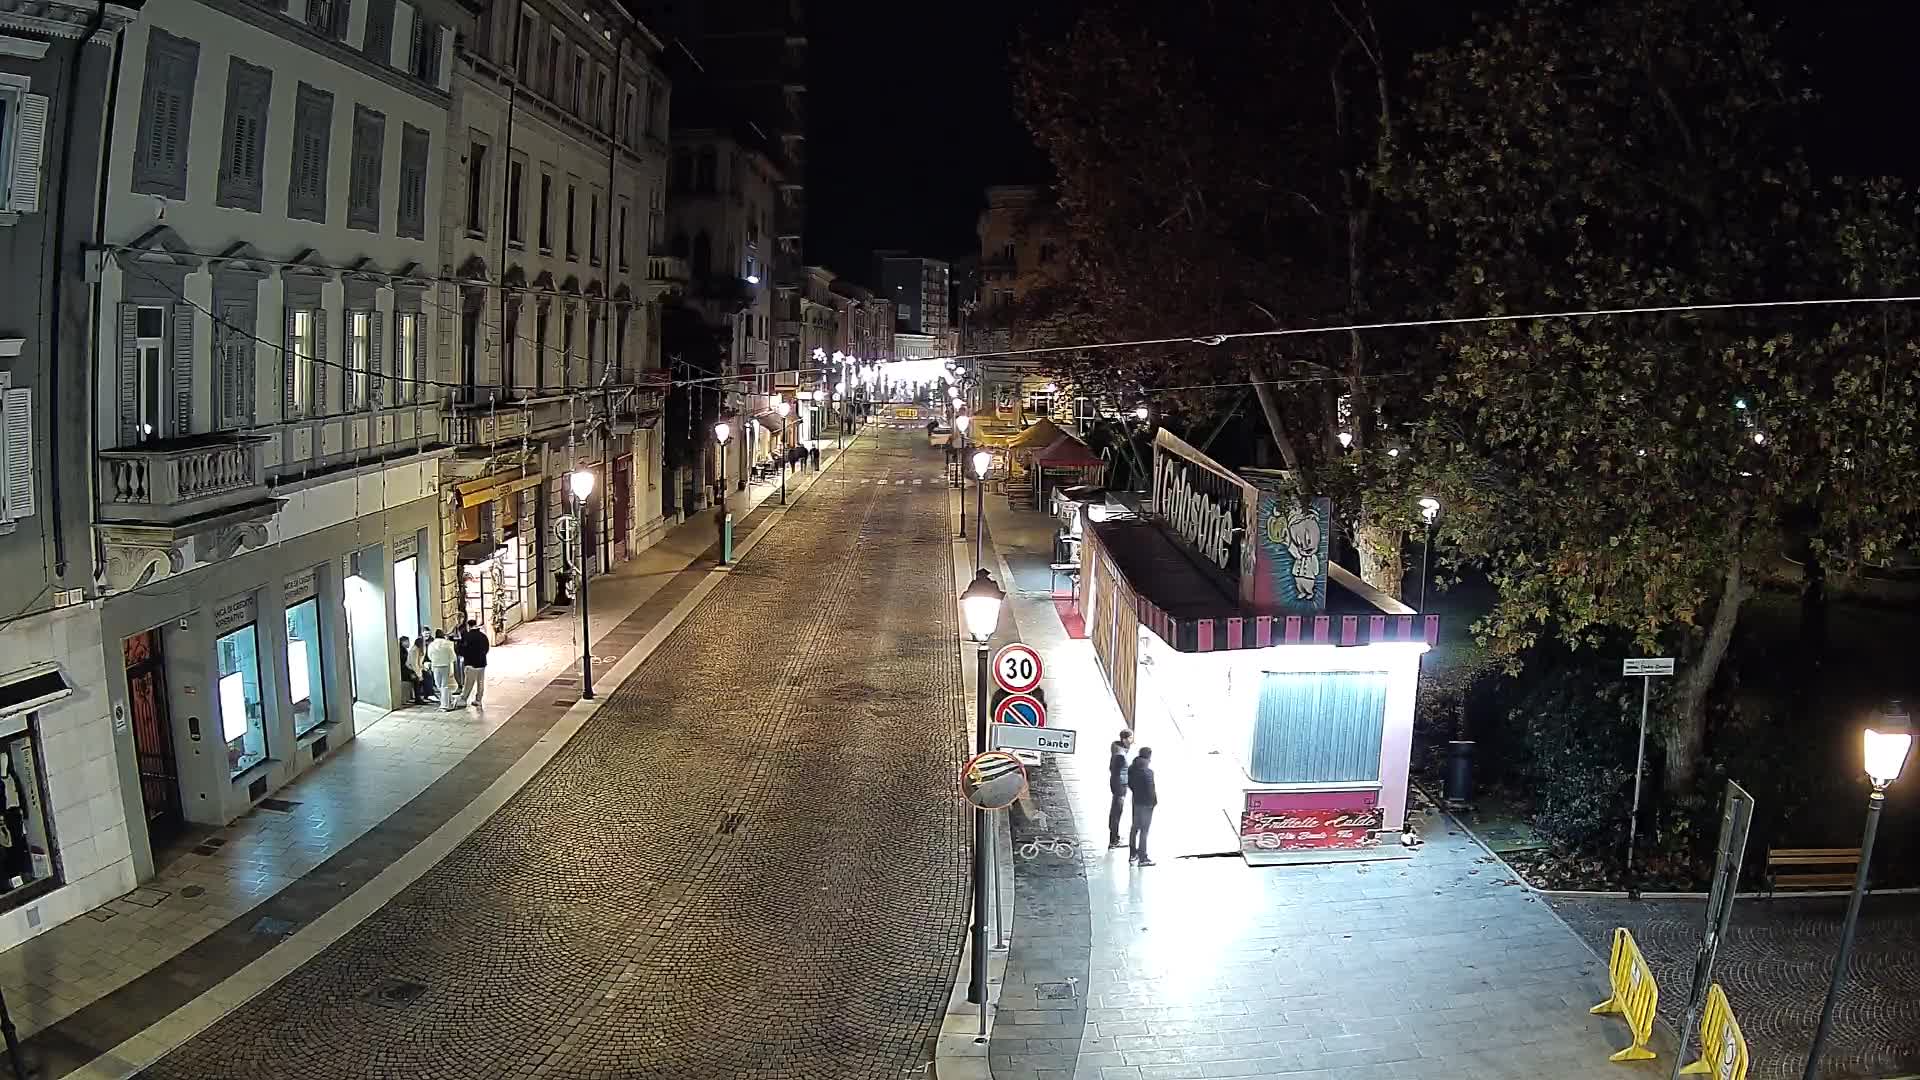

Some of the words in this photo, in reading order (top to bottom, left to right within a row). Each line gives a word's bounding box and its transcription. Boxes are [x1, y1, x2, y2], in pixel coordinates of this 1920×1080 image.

[1162, 458, 1233, 570] Golosone
[1006, 658, 1033, 680] 30
[1038, 737, 1070, 749] Dante
